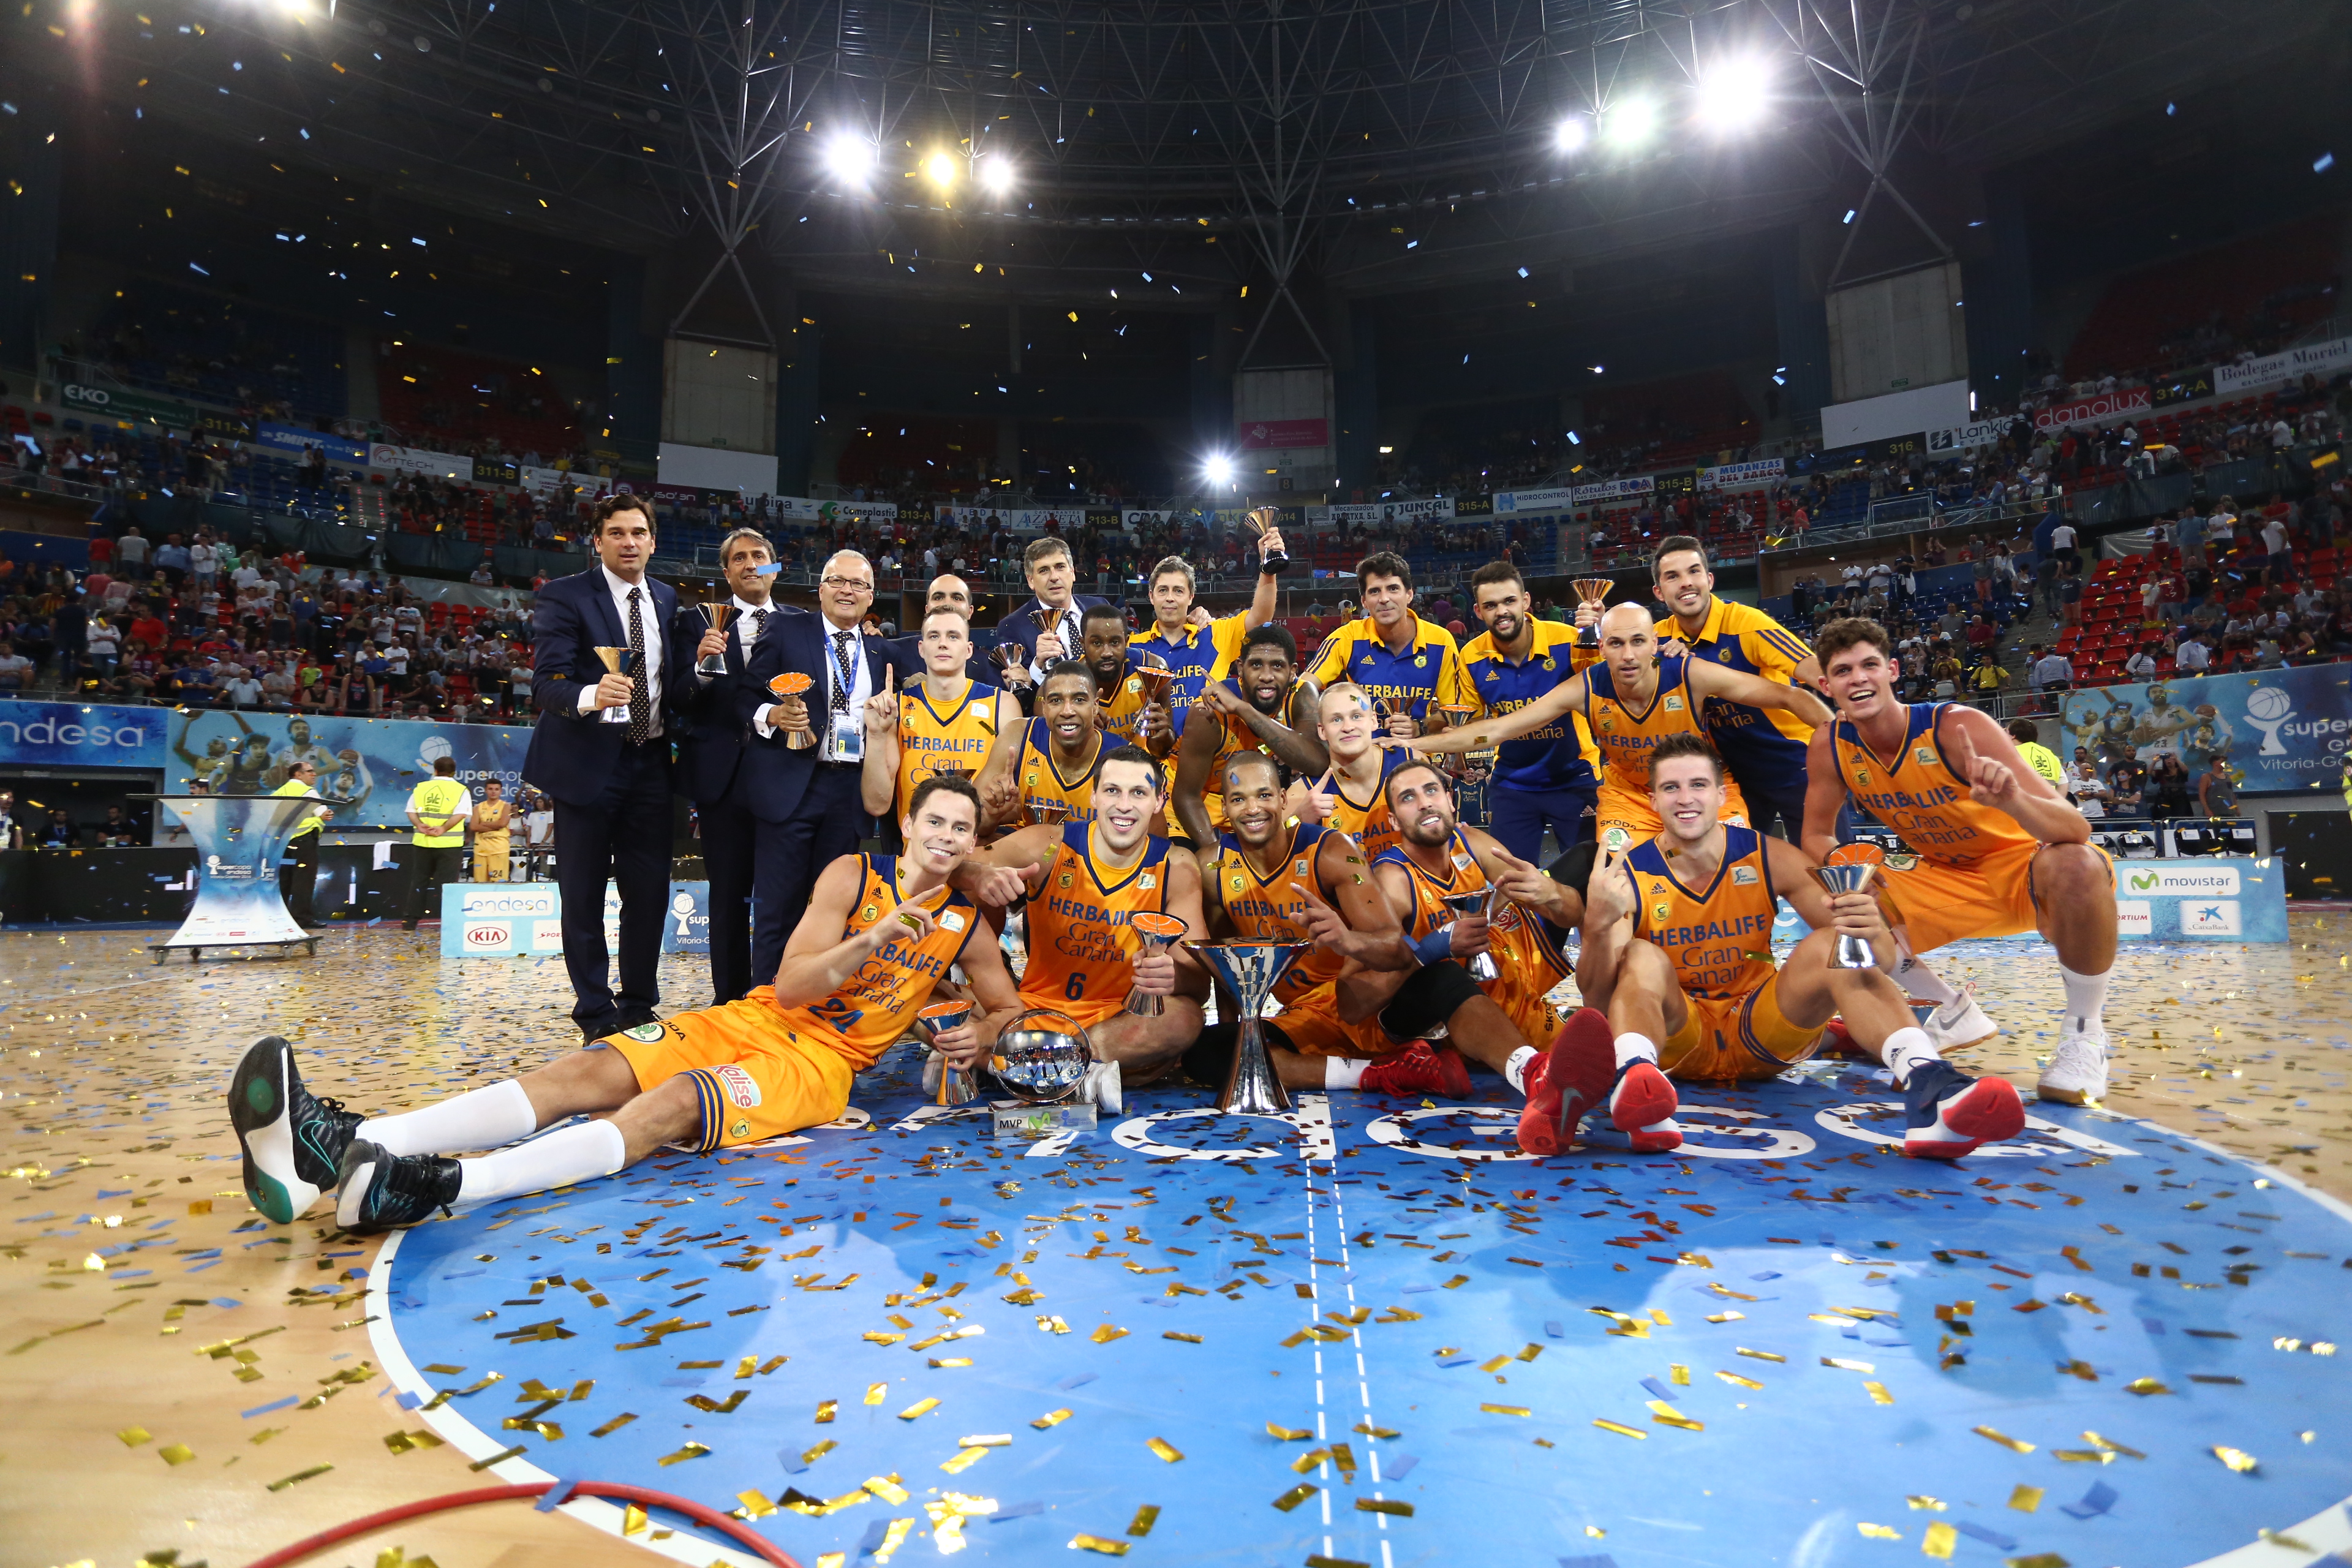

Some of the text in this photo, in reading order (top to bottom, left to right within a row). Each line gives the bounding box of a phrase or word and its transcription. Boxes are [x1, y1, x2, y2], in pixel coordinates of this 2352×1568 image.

[2222, 360, 2285, 381] Bodegas
[2037, 391, 2148, 428] danolux
[205, 418, 250, 435] 311-A
[1890, 441, 1913, 454] 316
[477, 466, 515, 479] 311-B
[1720, 460, 1780, 475] MUDANZAS
[1659, 477, 1692, 489] 315-B
[1719, 472, 1738, 483] DEL
[1517, 492, 1569, 501] HIDROCONTROL
[1574, 484, 1616, 496] Rótulos
[844, 506, 895, 518] Comeplastic
[1398, 500, 1450, 515] JUNCAL
[1459, 500, 1490, 511] 315-A
[900, 510, 931, 519] 313-A
[902, 735, 984, 753] HERBALIFE
[922, 753, 962, 770] Gran
[1893, 812, 1943, 829] Gran
[1909, 827, 1978, 844] anaria
[1367, 840, 1393, 857] ran
[2165, 876, 2231, 886] movistar
[471, 897, 548, 911] endesa
[475, 927, 500, 941] KIA
[1069, 922, 1116, 947] Gran
[1649, 914, 1766, 947] HERBALIFE
[2192, 923, 2230, 932] CaixaBank
[676, 937, 709, 945] Vitoria-G
[1055, 936, 1125, 962] Canaria
[1681, 945, 1741, 967] Gran
[859, 960, 907, 990] Gran
[1065, 973, 1087, 1000] 6
[806, 997, 865, 1034] 24
[1000, 1120, 1022, 1129] MVP
